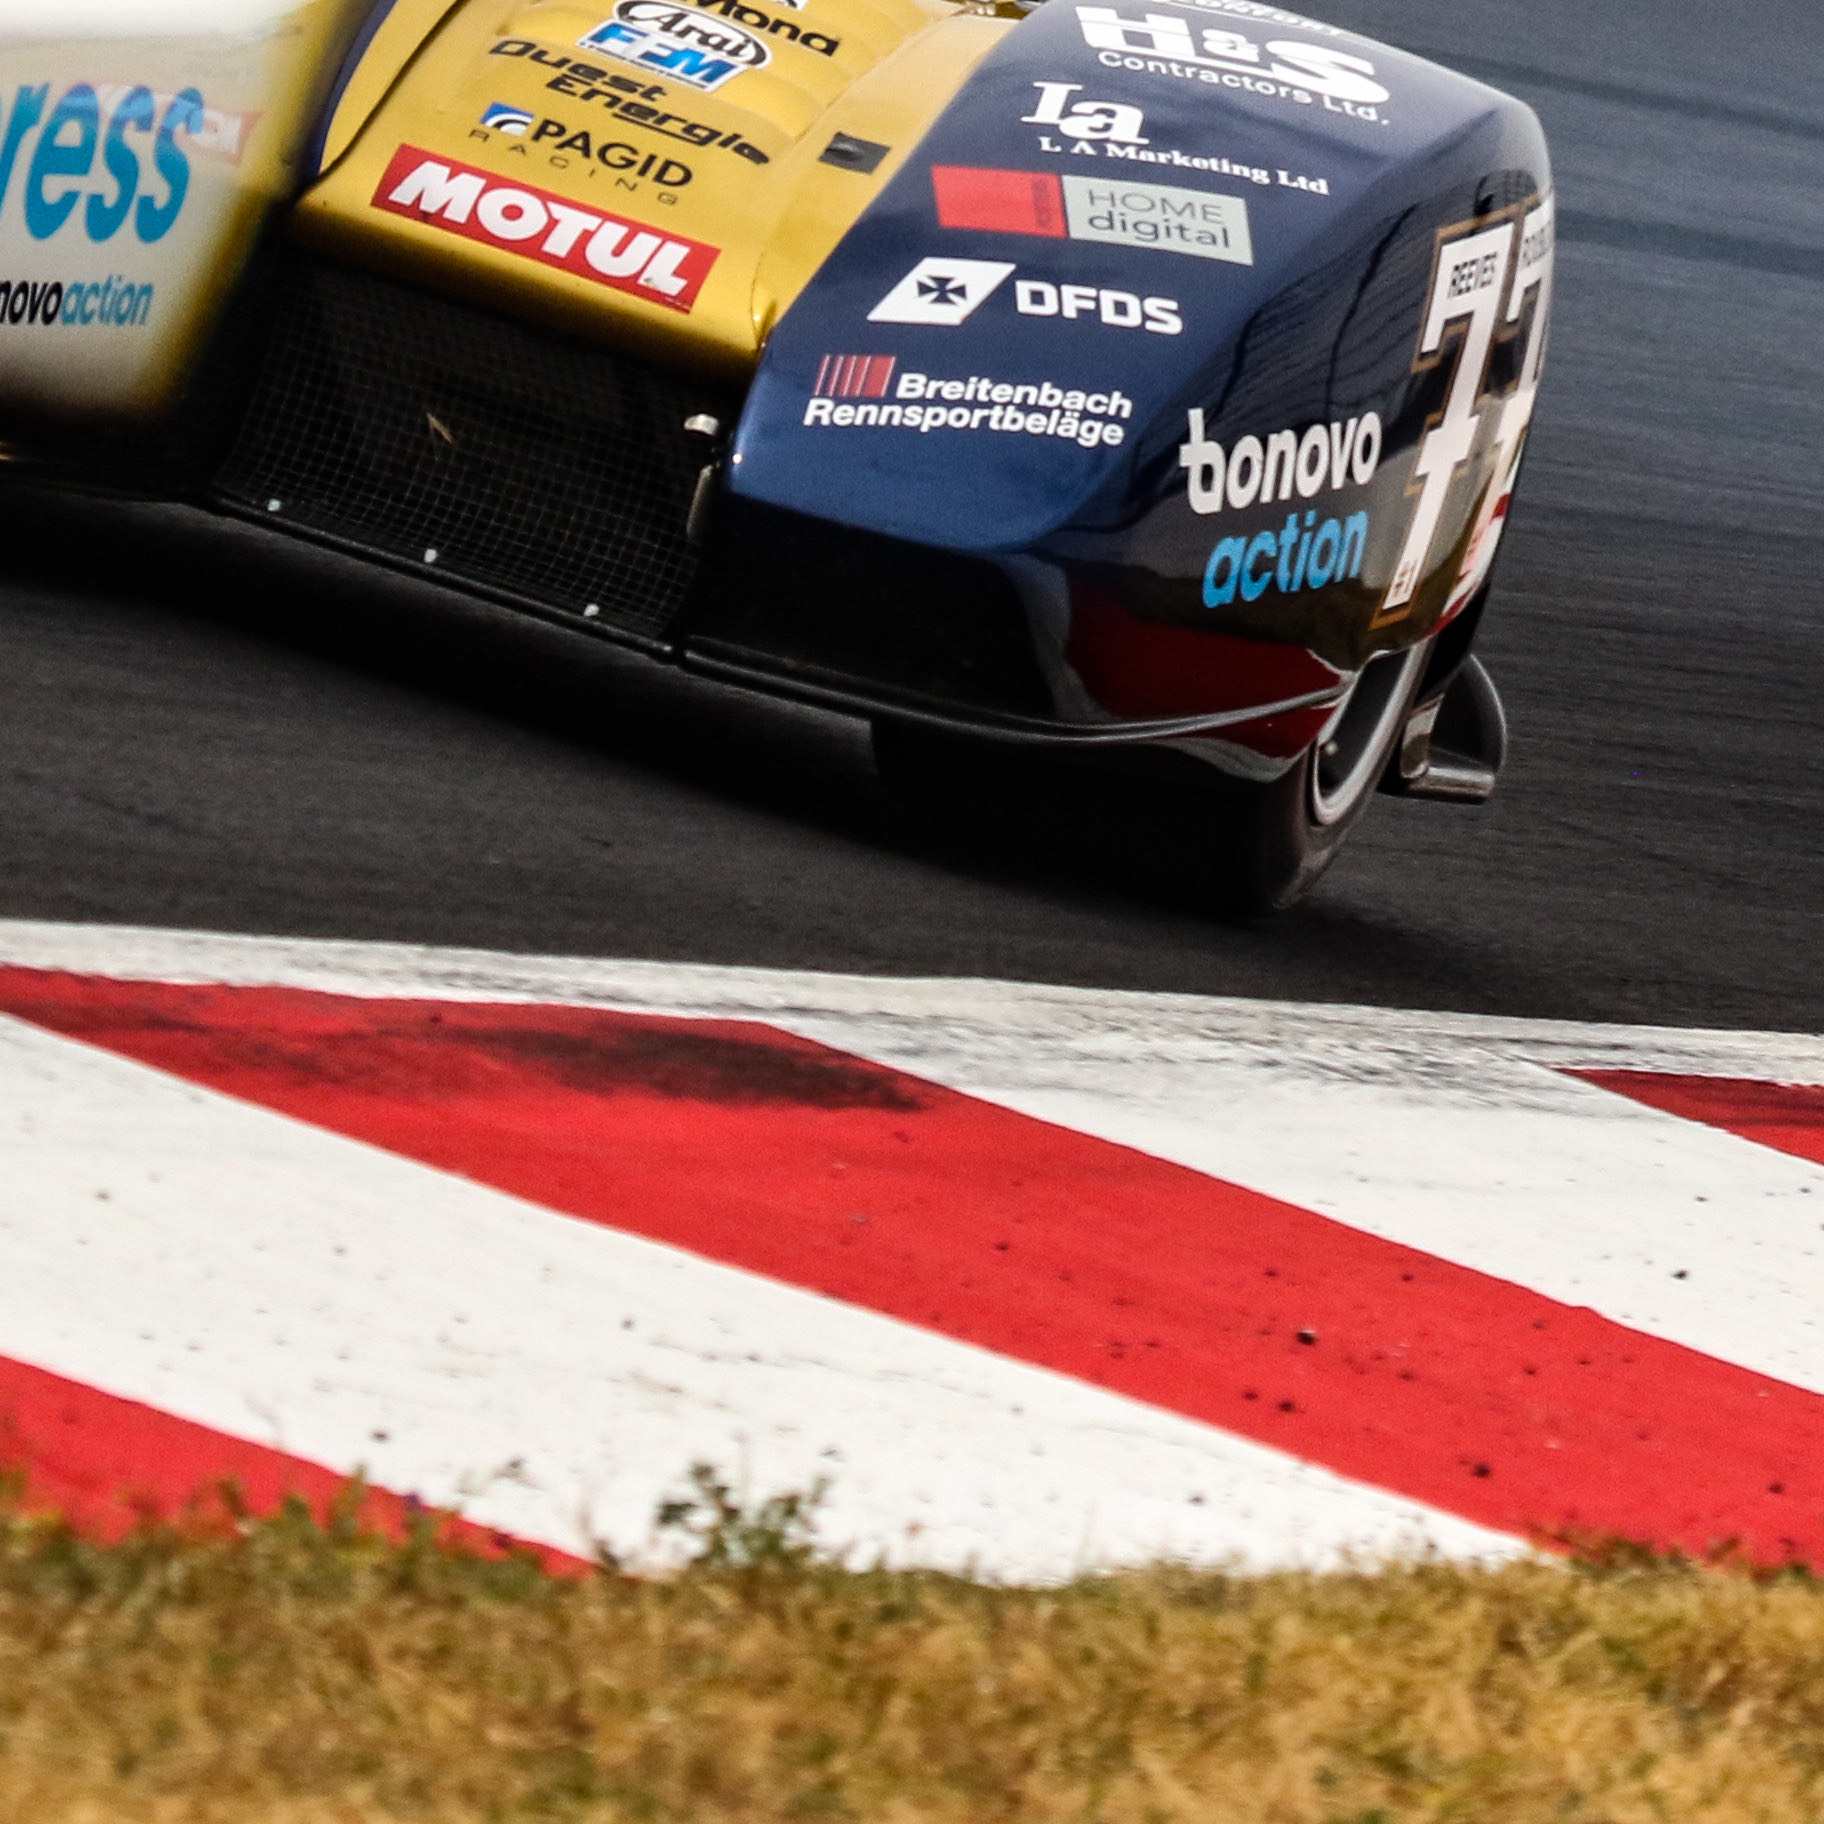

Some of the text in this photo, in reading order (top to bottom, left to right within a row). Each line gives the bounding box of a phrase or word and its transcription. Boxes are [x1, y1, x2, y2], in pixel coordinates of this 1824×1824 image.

[626, 10, 753, 58] Arai
[545, 73, 770, 165] Energie
[1098, 50, 1391, 126] Contractors Ltd.
[469, 130, 679, 205] RACING
[531, 118, 694, 189] PAGID
[1105, 142, 1270, 185] Marketing
[1276, 167, 1330, 196] Ltd
[388, 160, 690, 297] MOTUL
[1087, 188, 1224, 223] HOME
[1087, 209, 1230, 250] digital
[1014, 279, 1184, 336] DFDS
[803, 398, 1126, 447] Rennsportbeläge
[896, 372, 1133, 420] Breitenbach
[1179, 408, 1382, 515] bonovo
[1202, 509, 1369, 610] action
